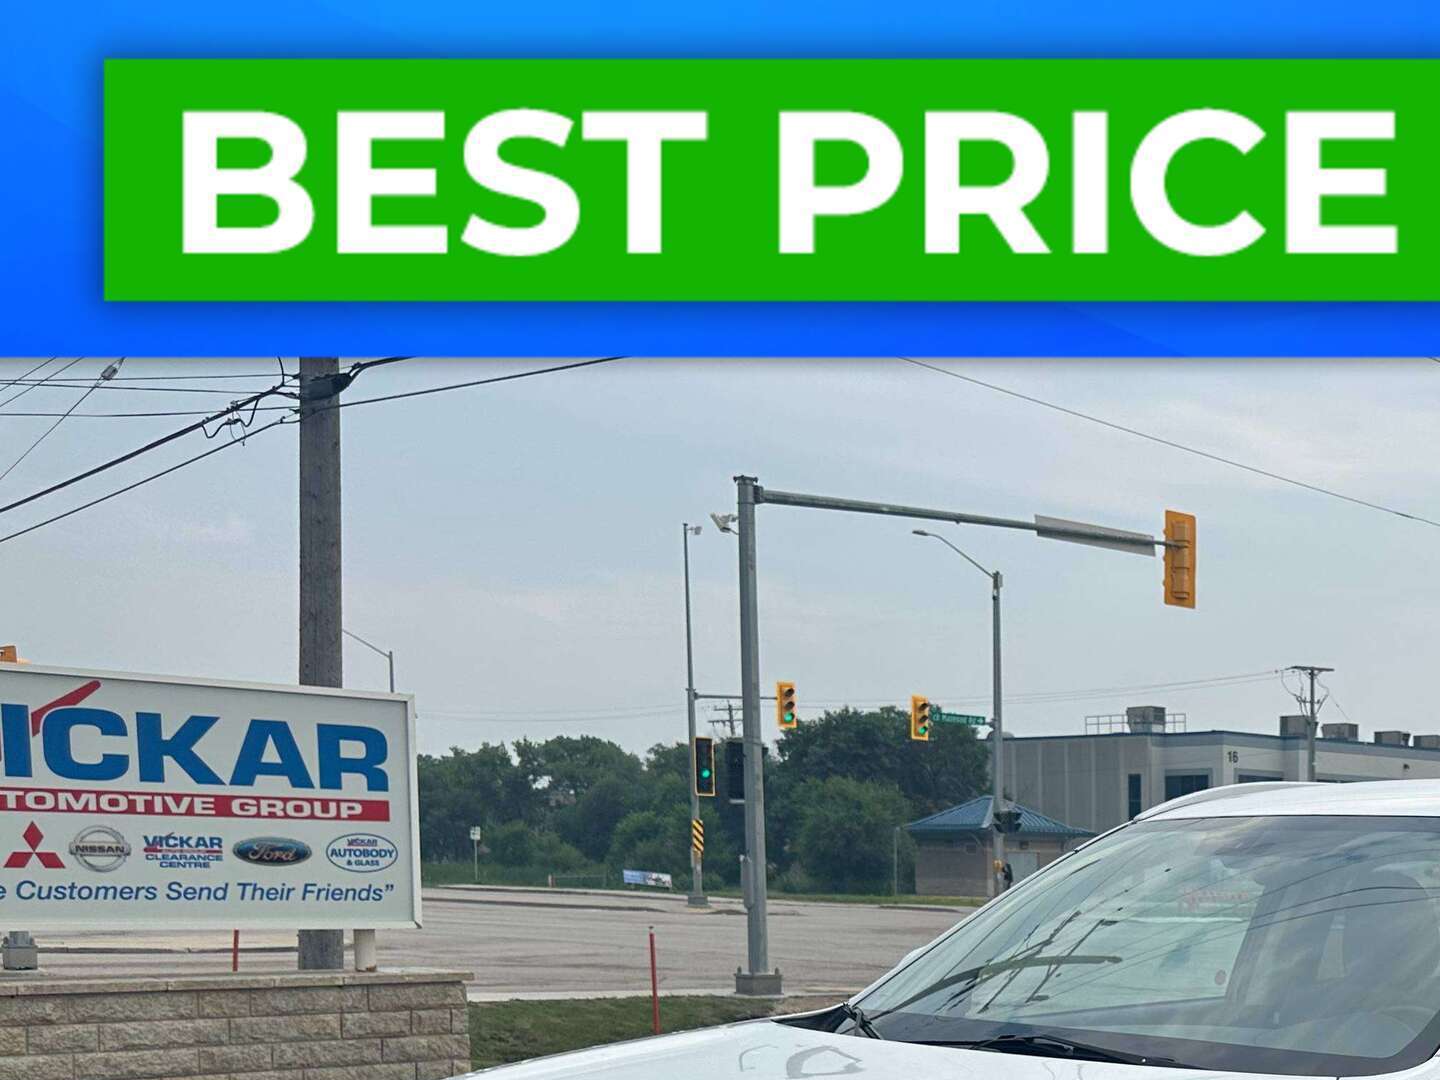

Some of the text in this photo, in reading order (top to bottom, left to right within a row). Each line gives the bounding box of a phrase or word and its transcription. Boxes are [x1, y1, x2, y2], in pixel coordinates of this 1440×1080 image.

[231, 798, 363, 819] GROUP
[143, 834, 223, 849] VICKAR
[75, 844, 125, 854] NISSAN
[249, 842, 298, 862] Ford
[330, 848, 394, 858] AUTOBODY
[145, 853, 224, 862] CLEARANCE
[159, 861, 210, 869] CENTRE
[354, 859, 380, 867] GLASS
[16, 880, 158, 901] Customers
[165, 881, 229, 901] Send
[236, 883, 296, 901] Their
